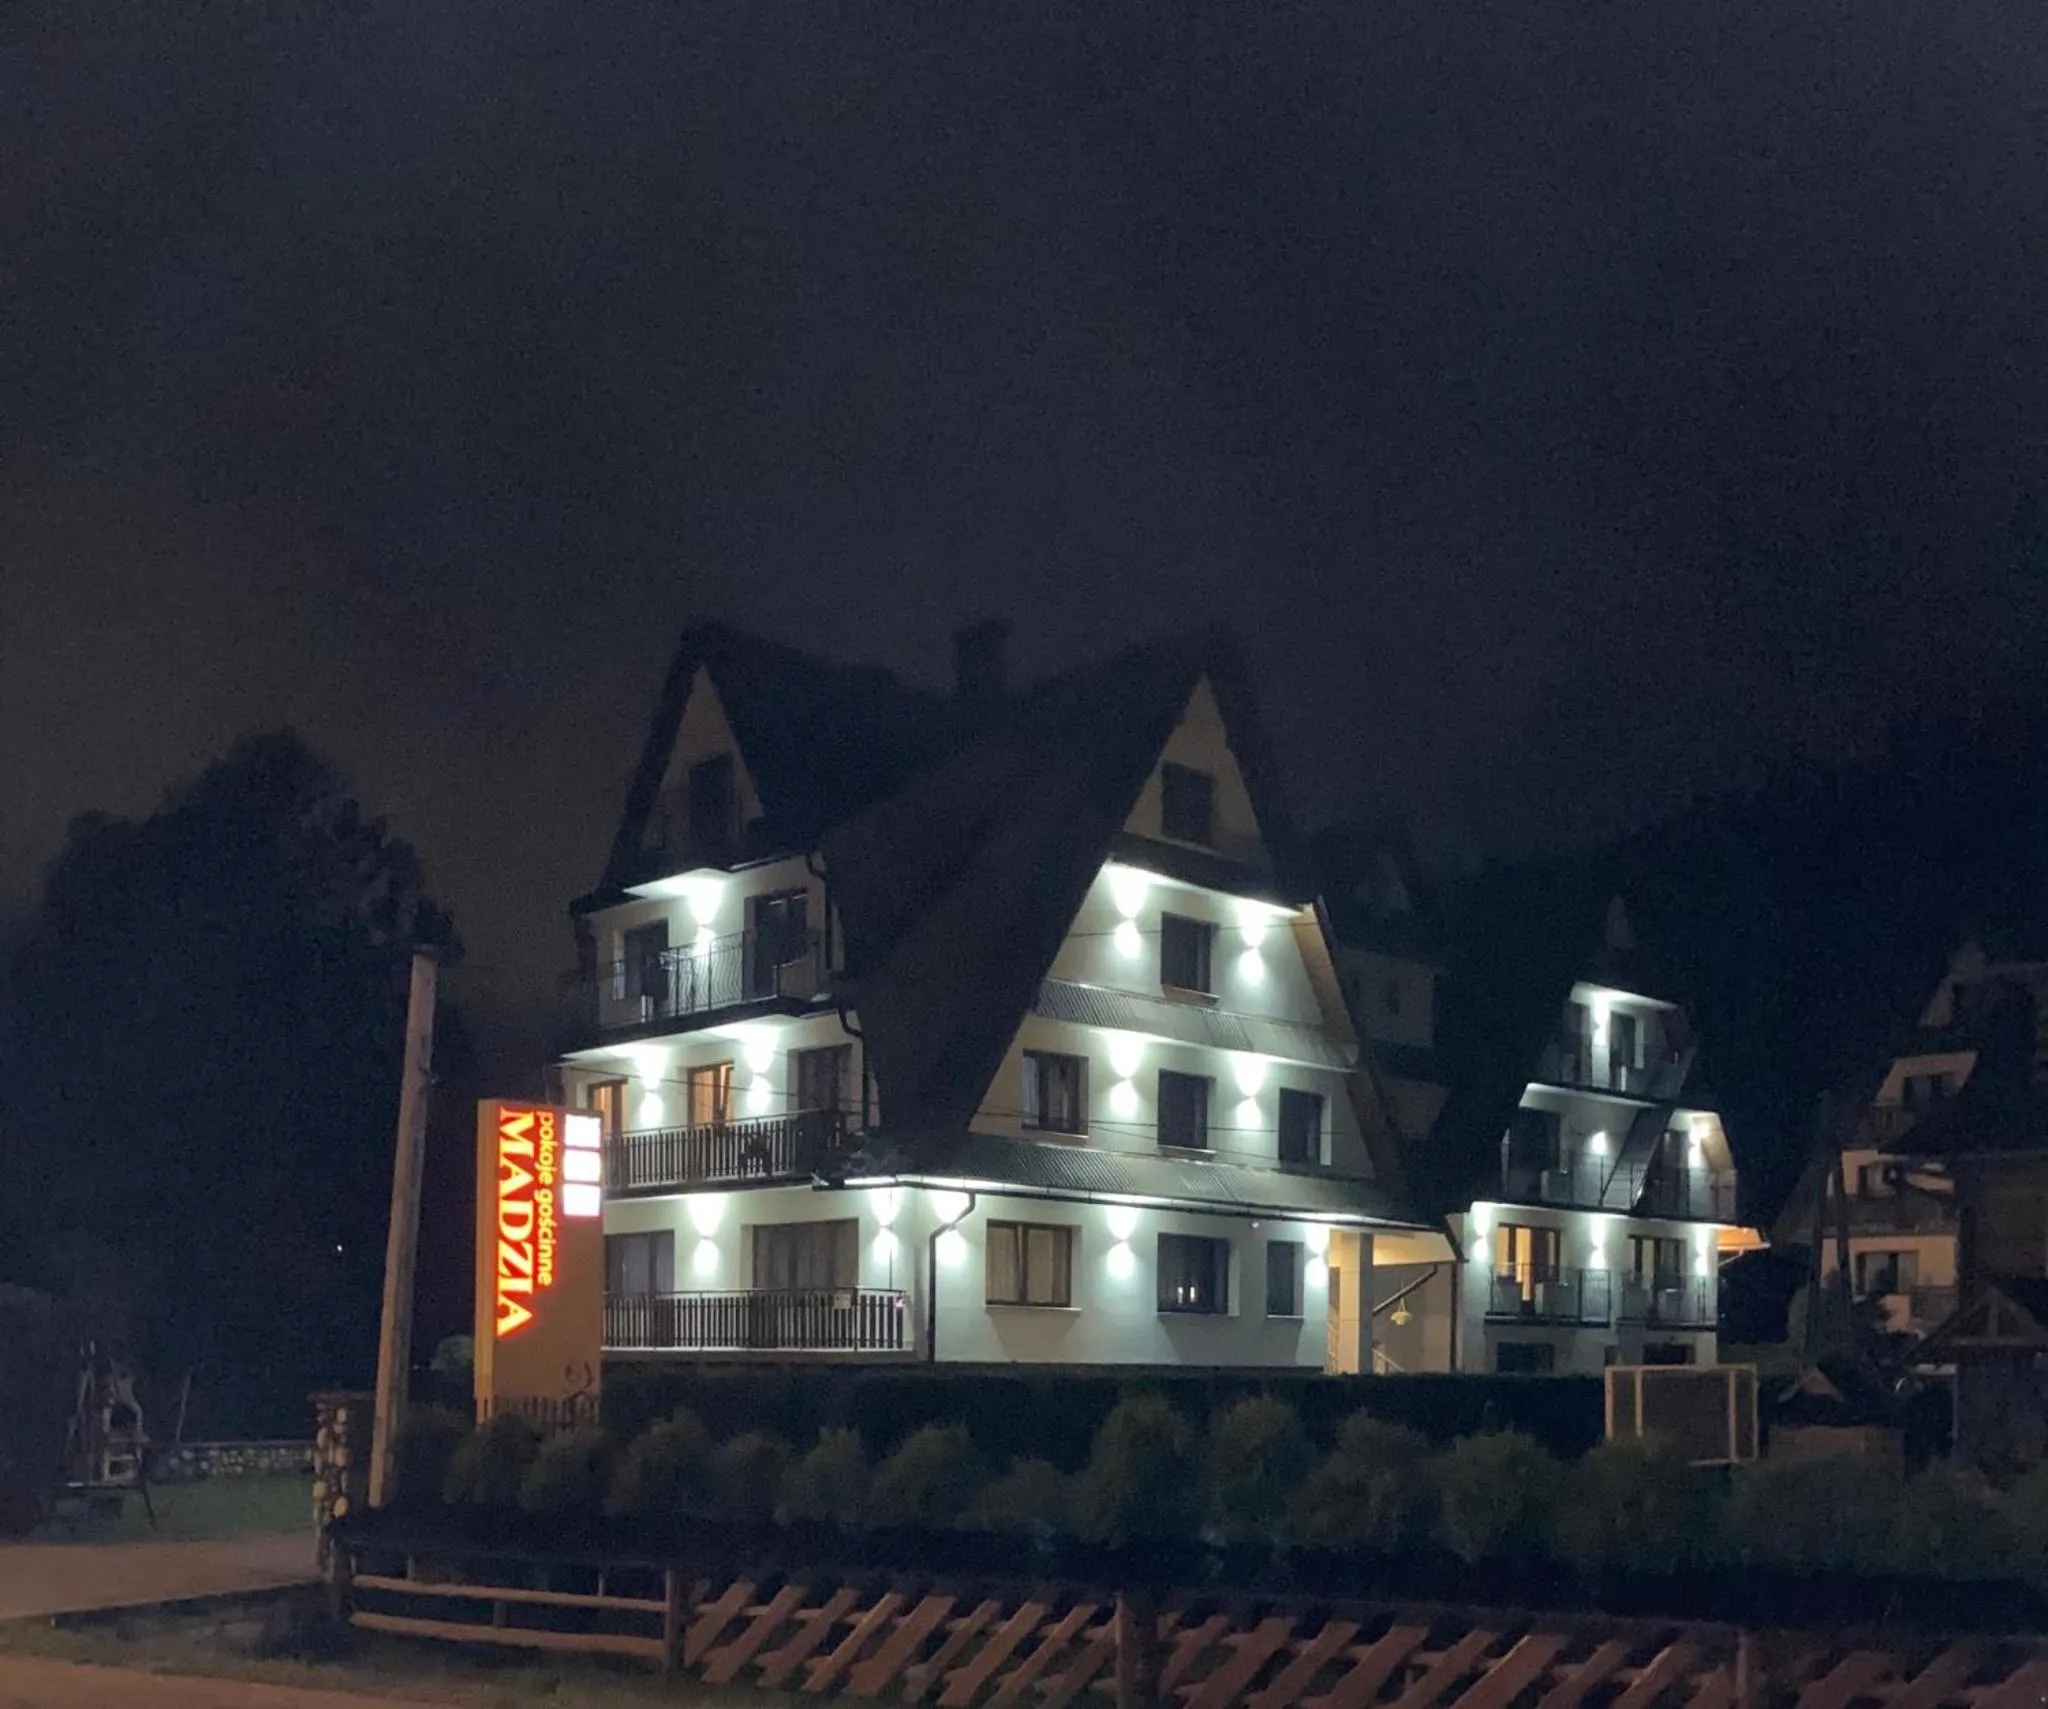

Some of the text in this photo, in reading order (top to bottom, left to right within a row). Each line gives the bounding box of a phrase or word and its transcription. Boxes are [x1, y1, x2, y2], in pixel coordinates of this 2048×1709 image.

[497, 1107, 535, 1337] MADZIA
[534, 1110, 559, 1286] pokoje gościnne
